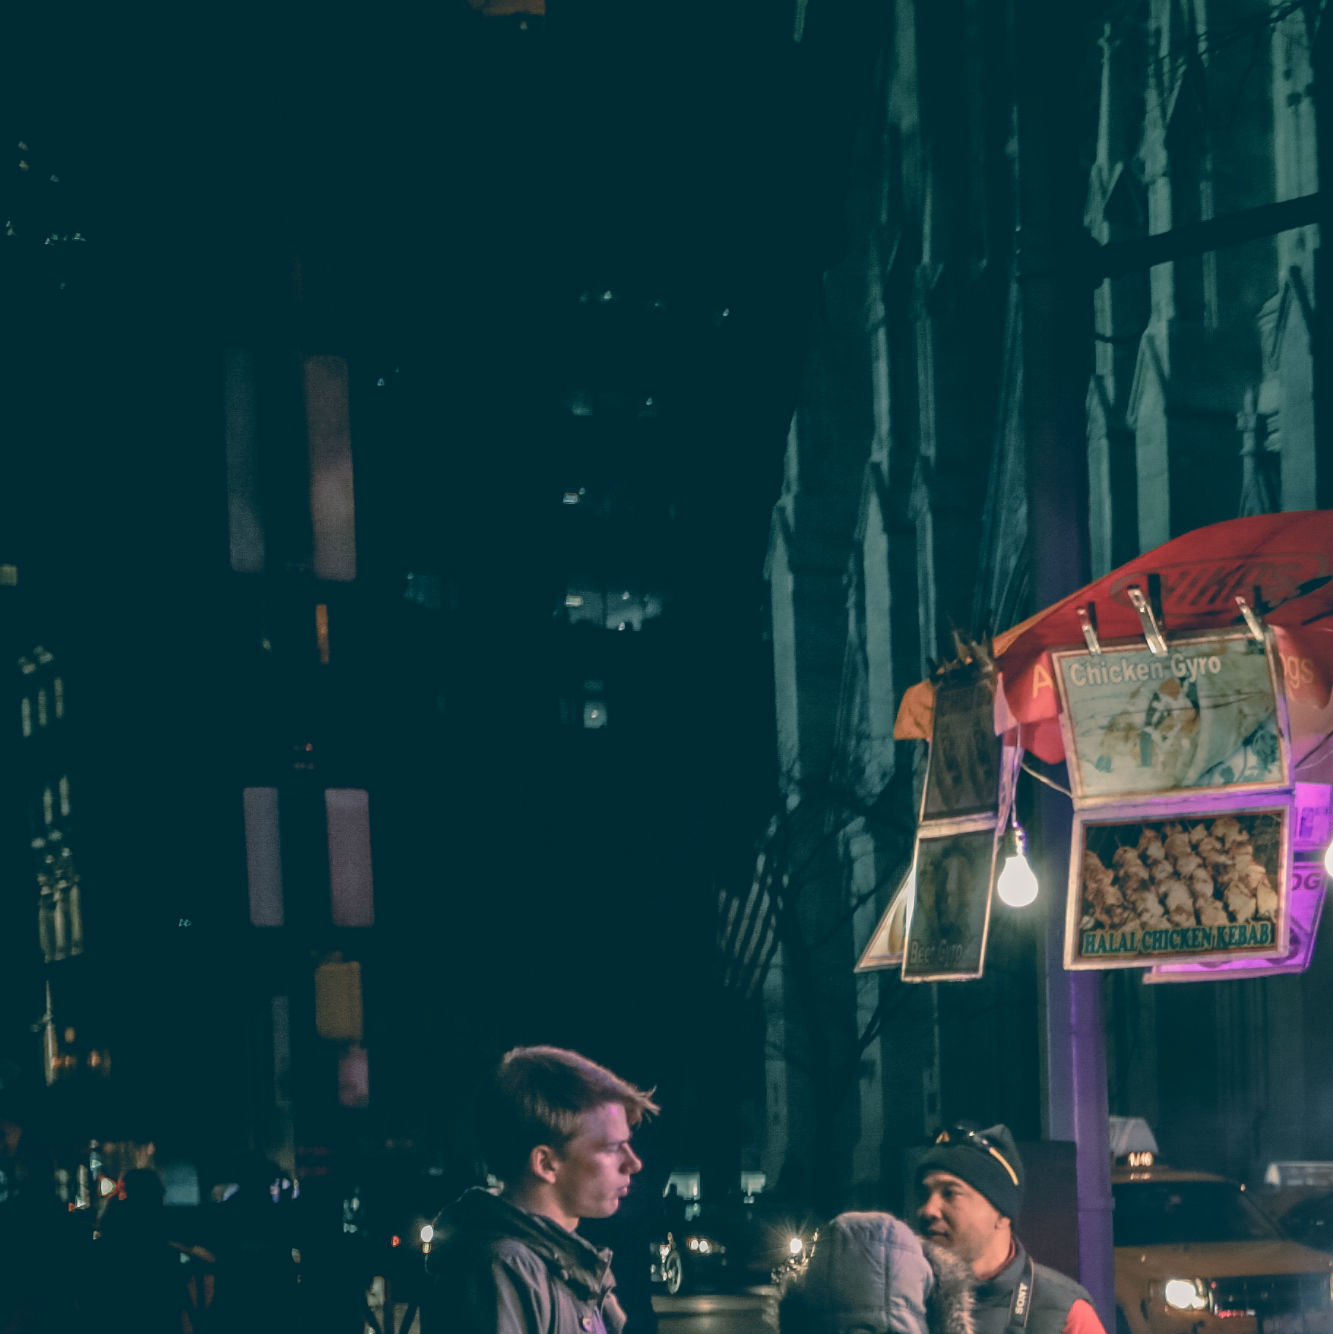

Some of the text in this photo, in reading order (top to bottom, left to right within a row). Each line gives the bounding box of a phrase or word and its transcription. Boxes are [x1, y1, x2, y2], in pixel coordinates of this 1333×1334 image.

[1069, 653, 1222, 688] Chicken Gyro
[1083, 921, 1272, 955] HALAL CHICKEN KEBAB
